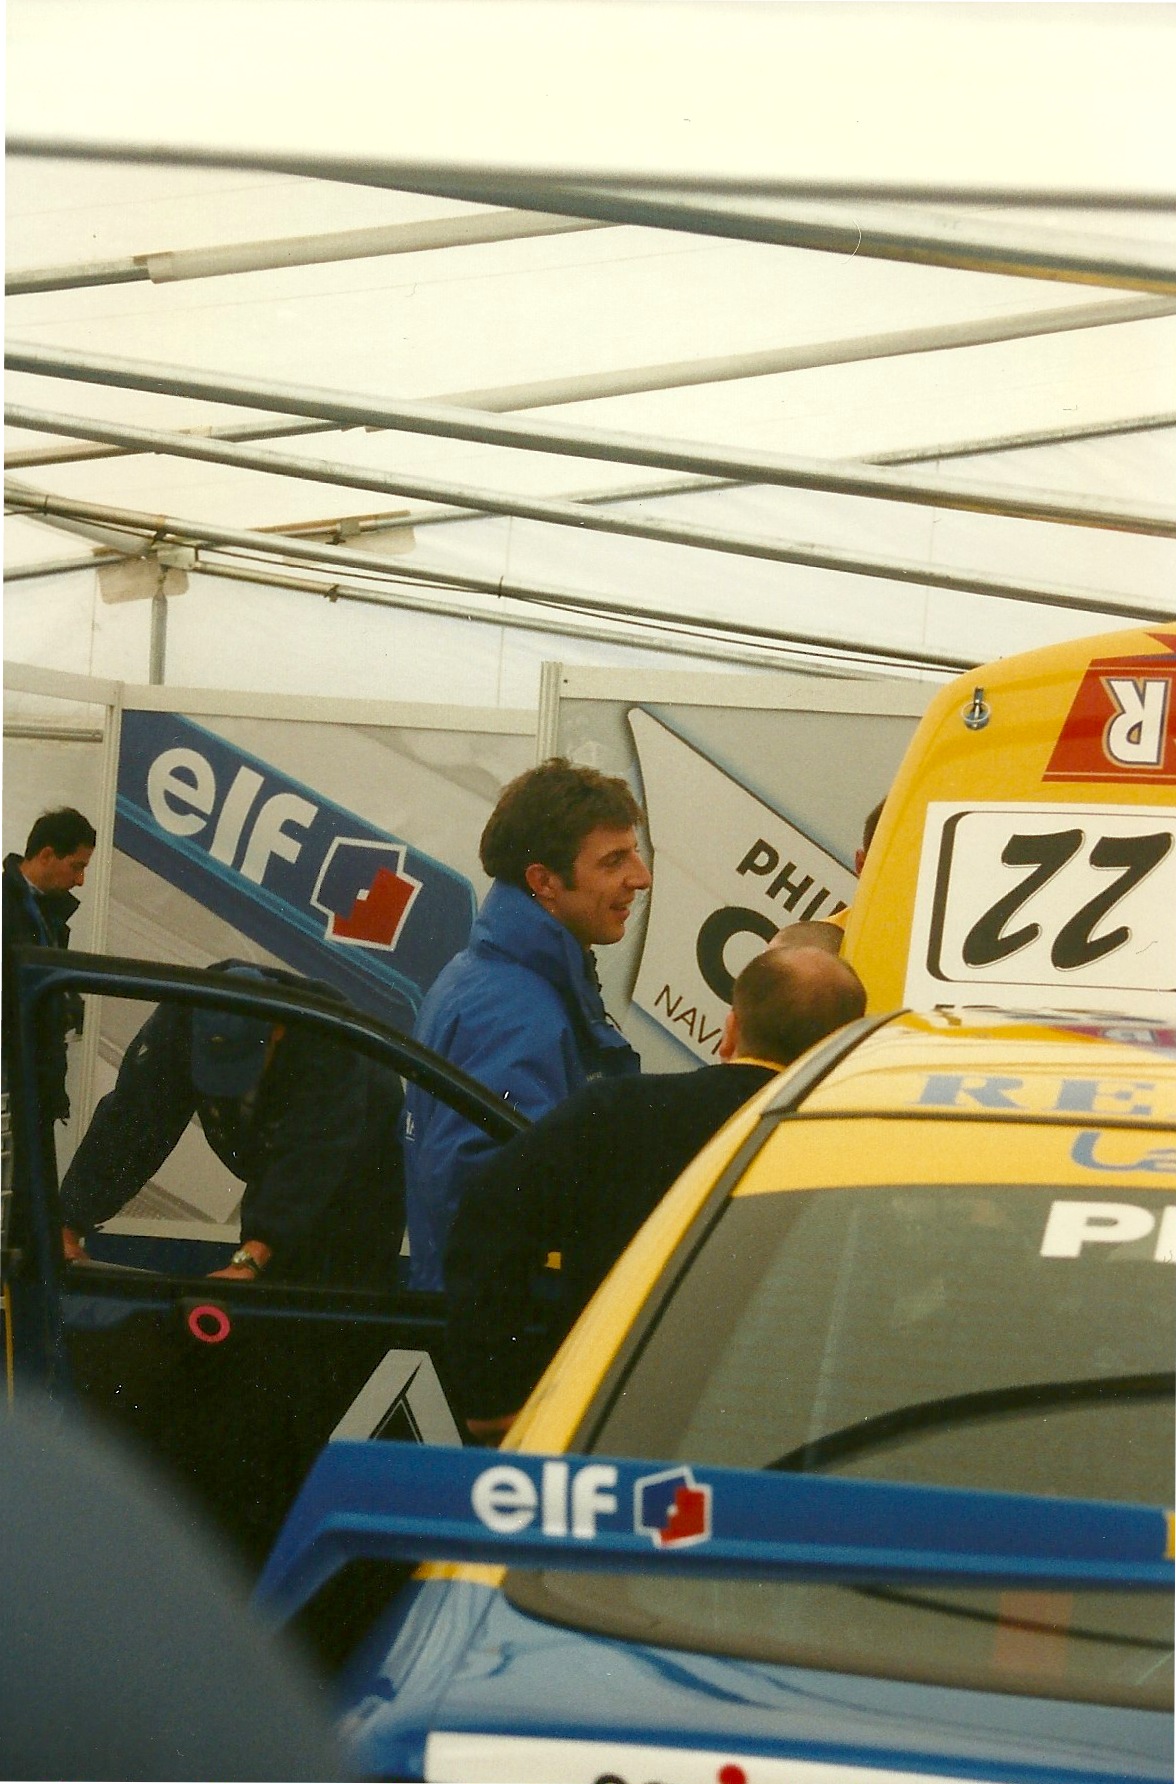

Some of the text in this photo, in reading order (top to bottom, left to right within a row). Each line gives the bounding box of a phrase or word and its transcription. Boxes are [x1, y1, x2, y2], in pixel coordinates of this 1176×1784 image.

[146, 747, 318, 885] elf
[962, 829, 1174, 971] 22
[471, 1461, 618, 1539] elf
